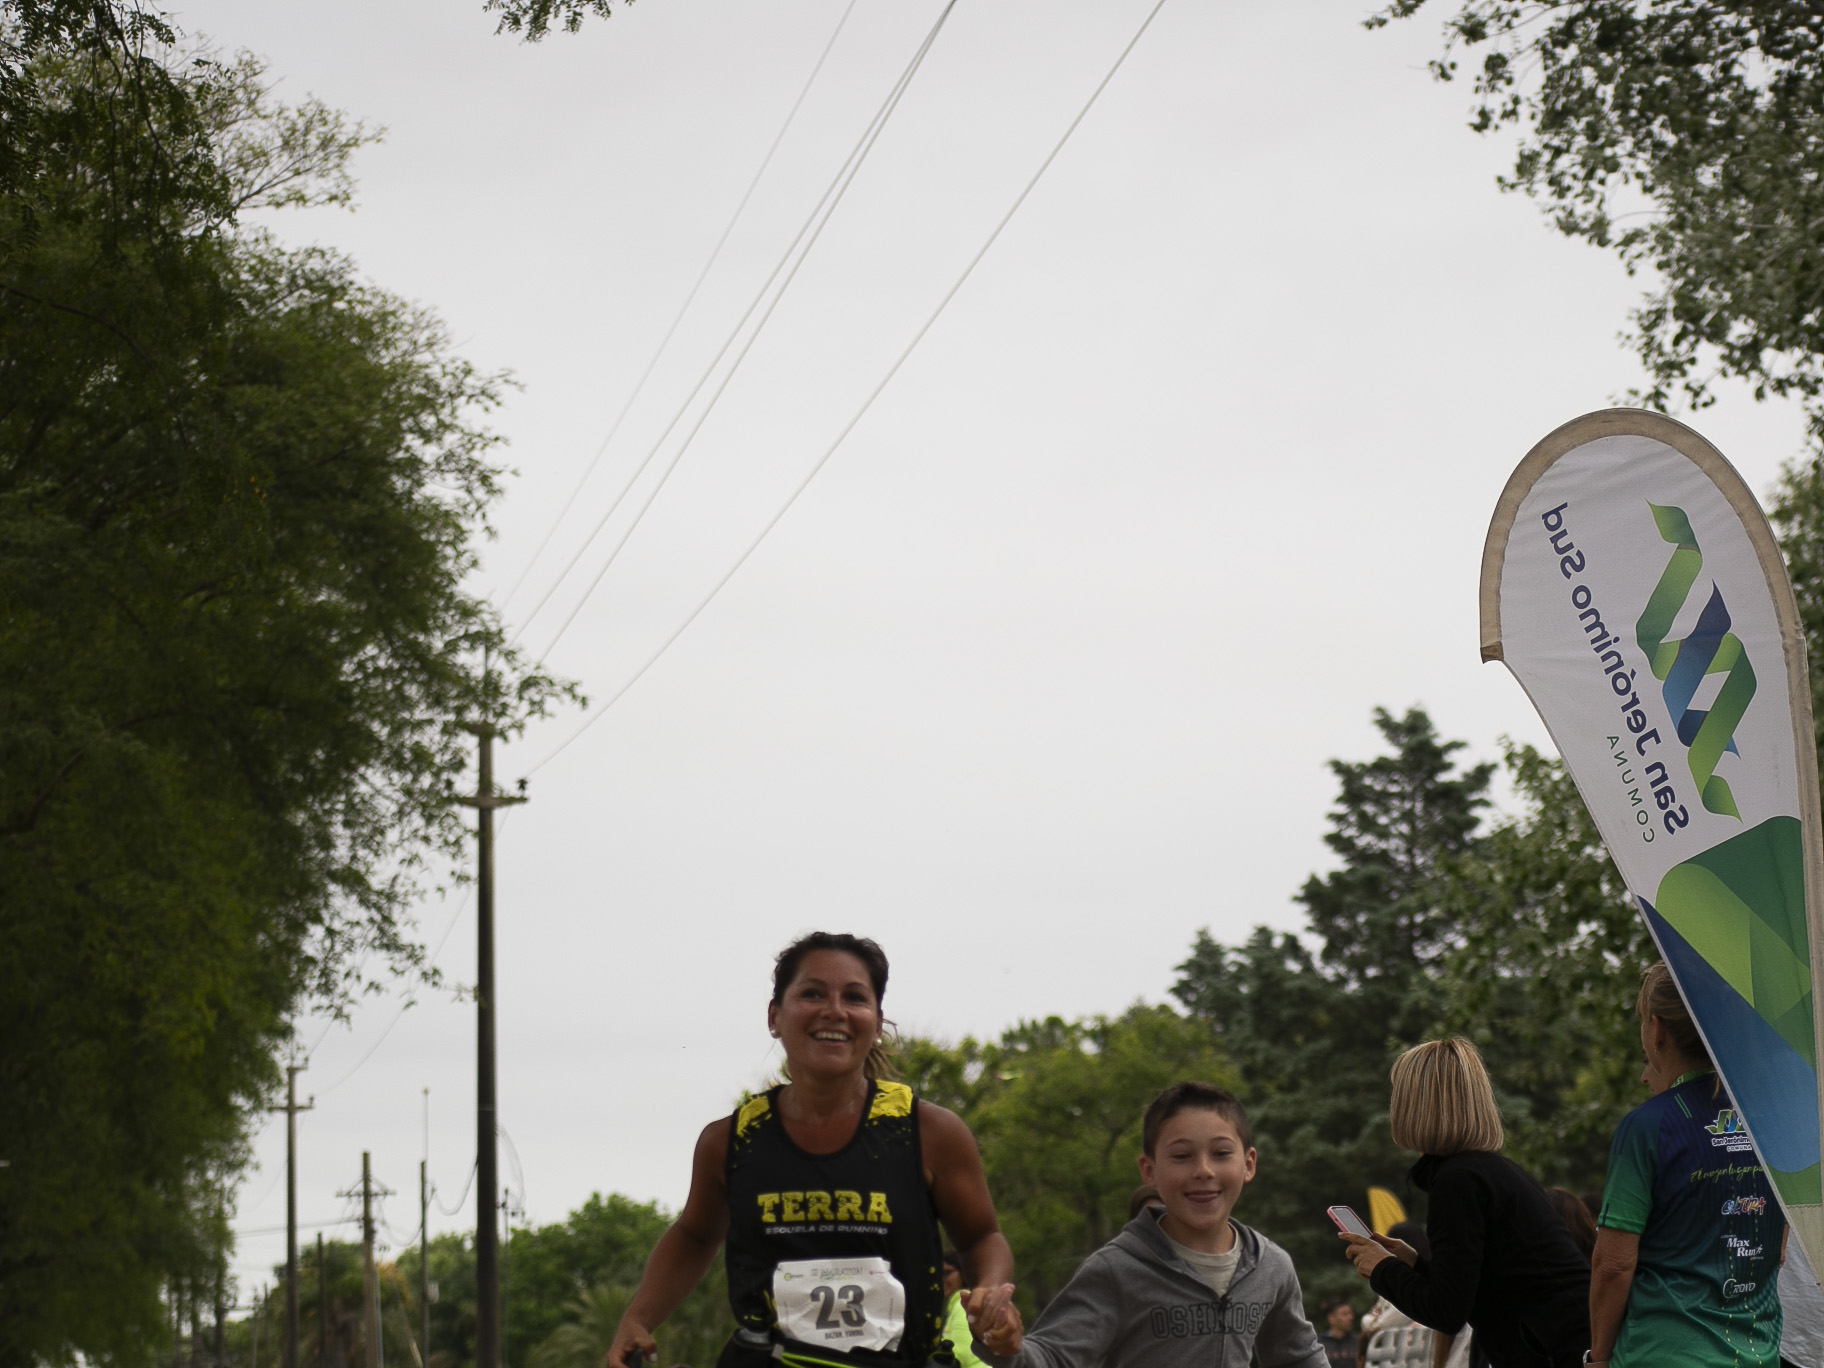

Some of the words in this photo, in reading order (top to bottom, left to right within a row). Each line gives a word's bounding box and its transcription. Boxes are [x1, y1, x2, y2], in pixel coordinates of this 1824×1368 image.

[1712, 1137, 1724, 1146] San
[1724, 1135, 1751, 1145] Jerónim
[757, 1190, 893, 1224] TERRA
[765, 1225, 816, 1235] ESCUELA
[837, 1225, 888, 1235] RUNNING
[1727, 1237, 1750, 1248] Max
[1737, 1247, 1756, 1257] Run
[810, 1284, 867, 1330] 23
